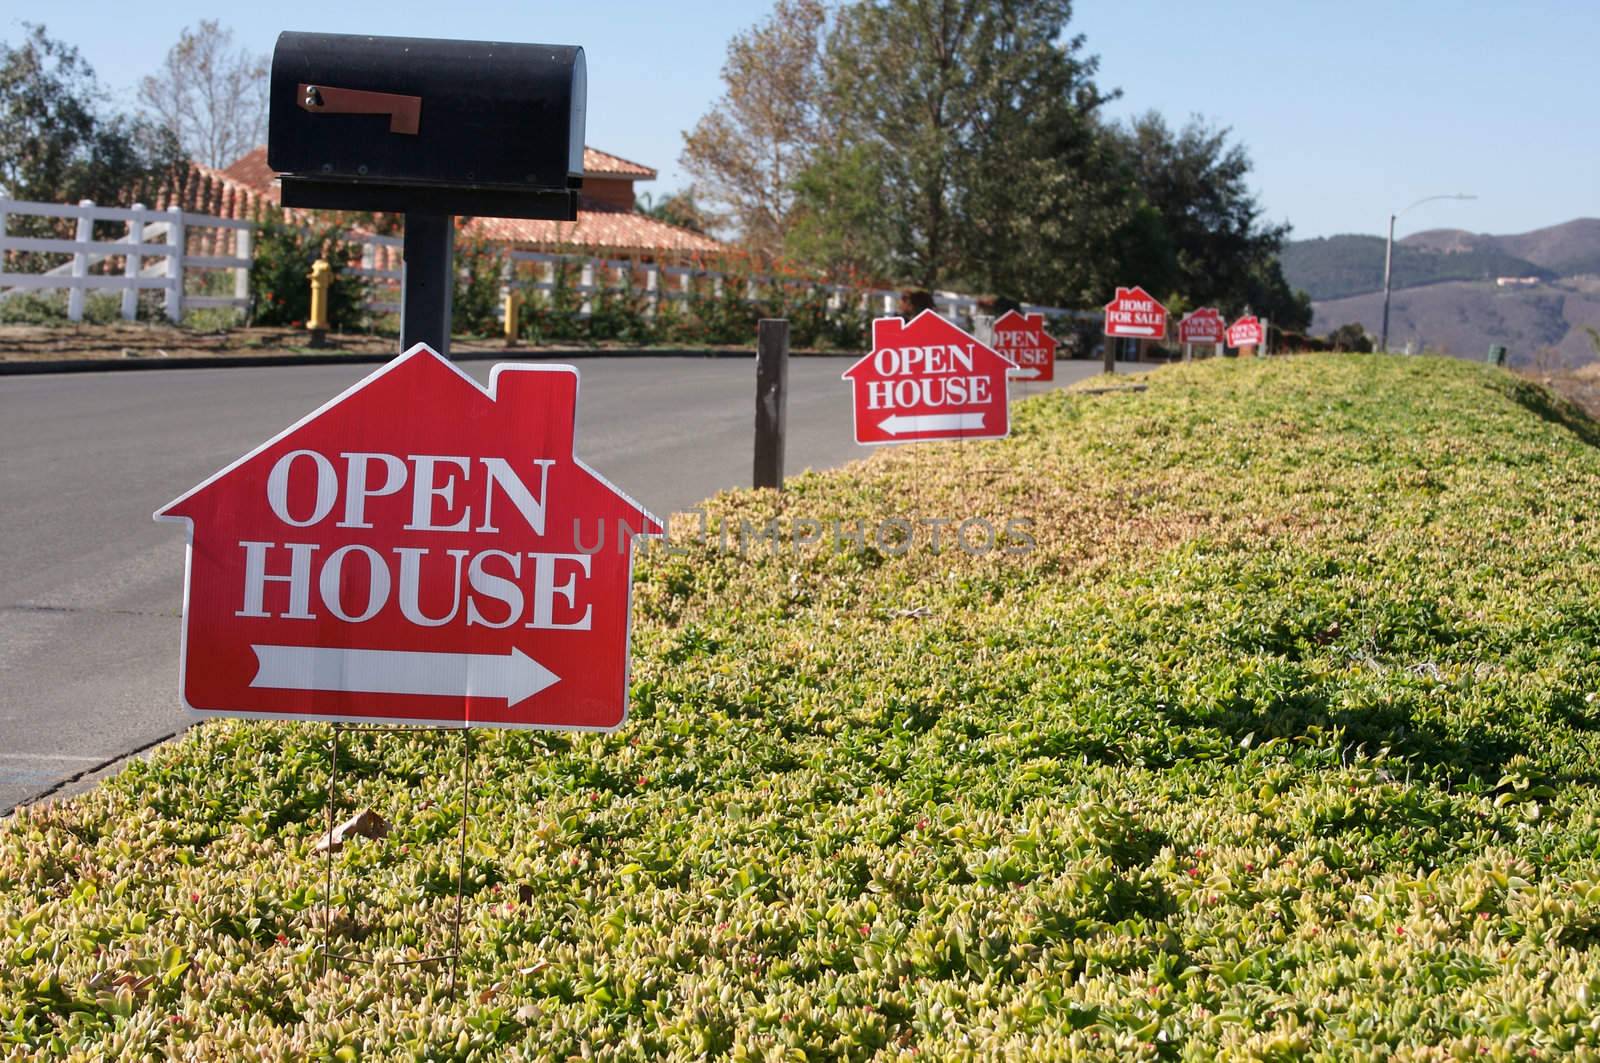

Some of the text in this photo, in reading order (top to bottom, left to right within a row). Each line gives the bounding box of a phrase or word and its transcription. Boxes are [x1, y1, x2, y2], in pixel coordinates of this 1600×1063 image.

[1110, 312, 1163, 324] FOR SALE
[1119, 299, 1153, 312] HOME
[874, 344, 975, 377] OPEN
[997, 348, 1048, 365] OUSE
[866, 375, 992, 410] HOUSE
[266, 449, 556, 537] OPEN
[235, 541, 592, 631] HOUSE
